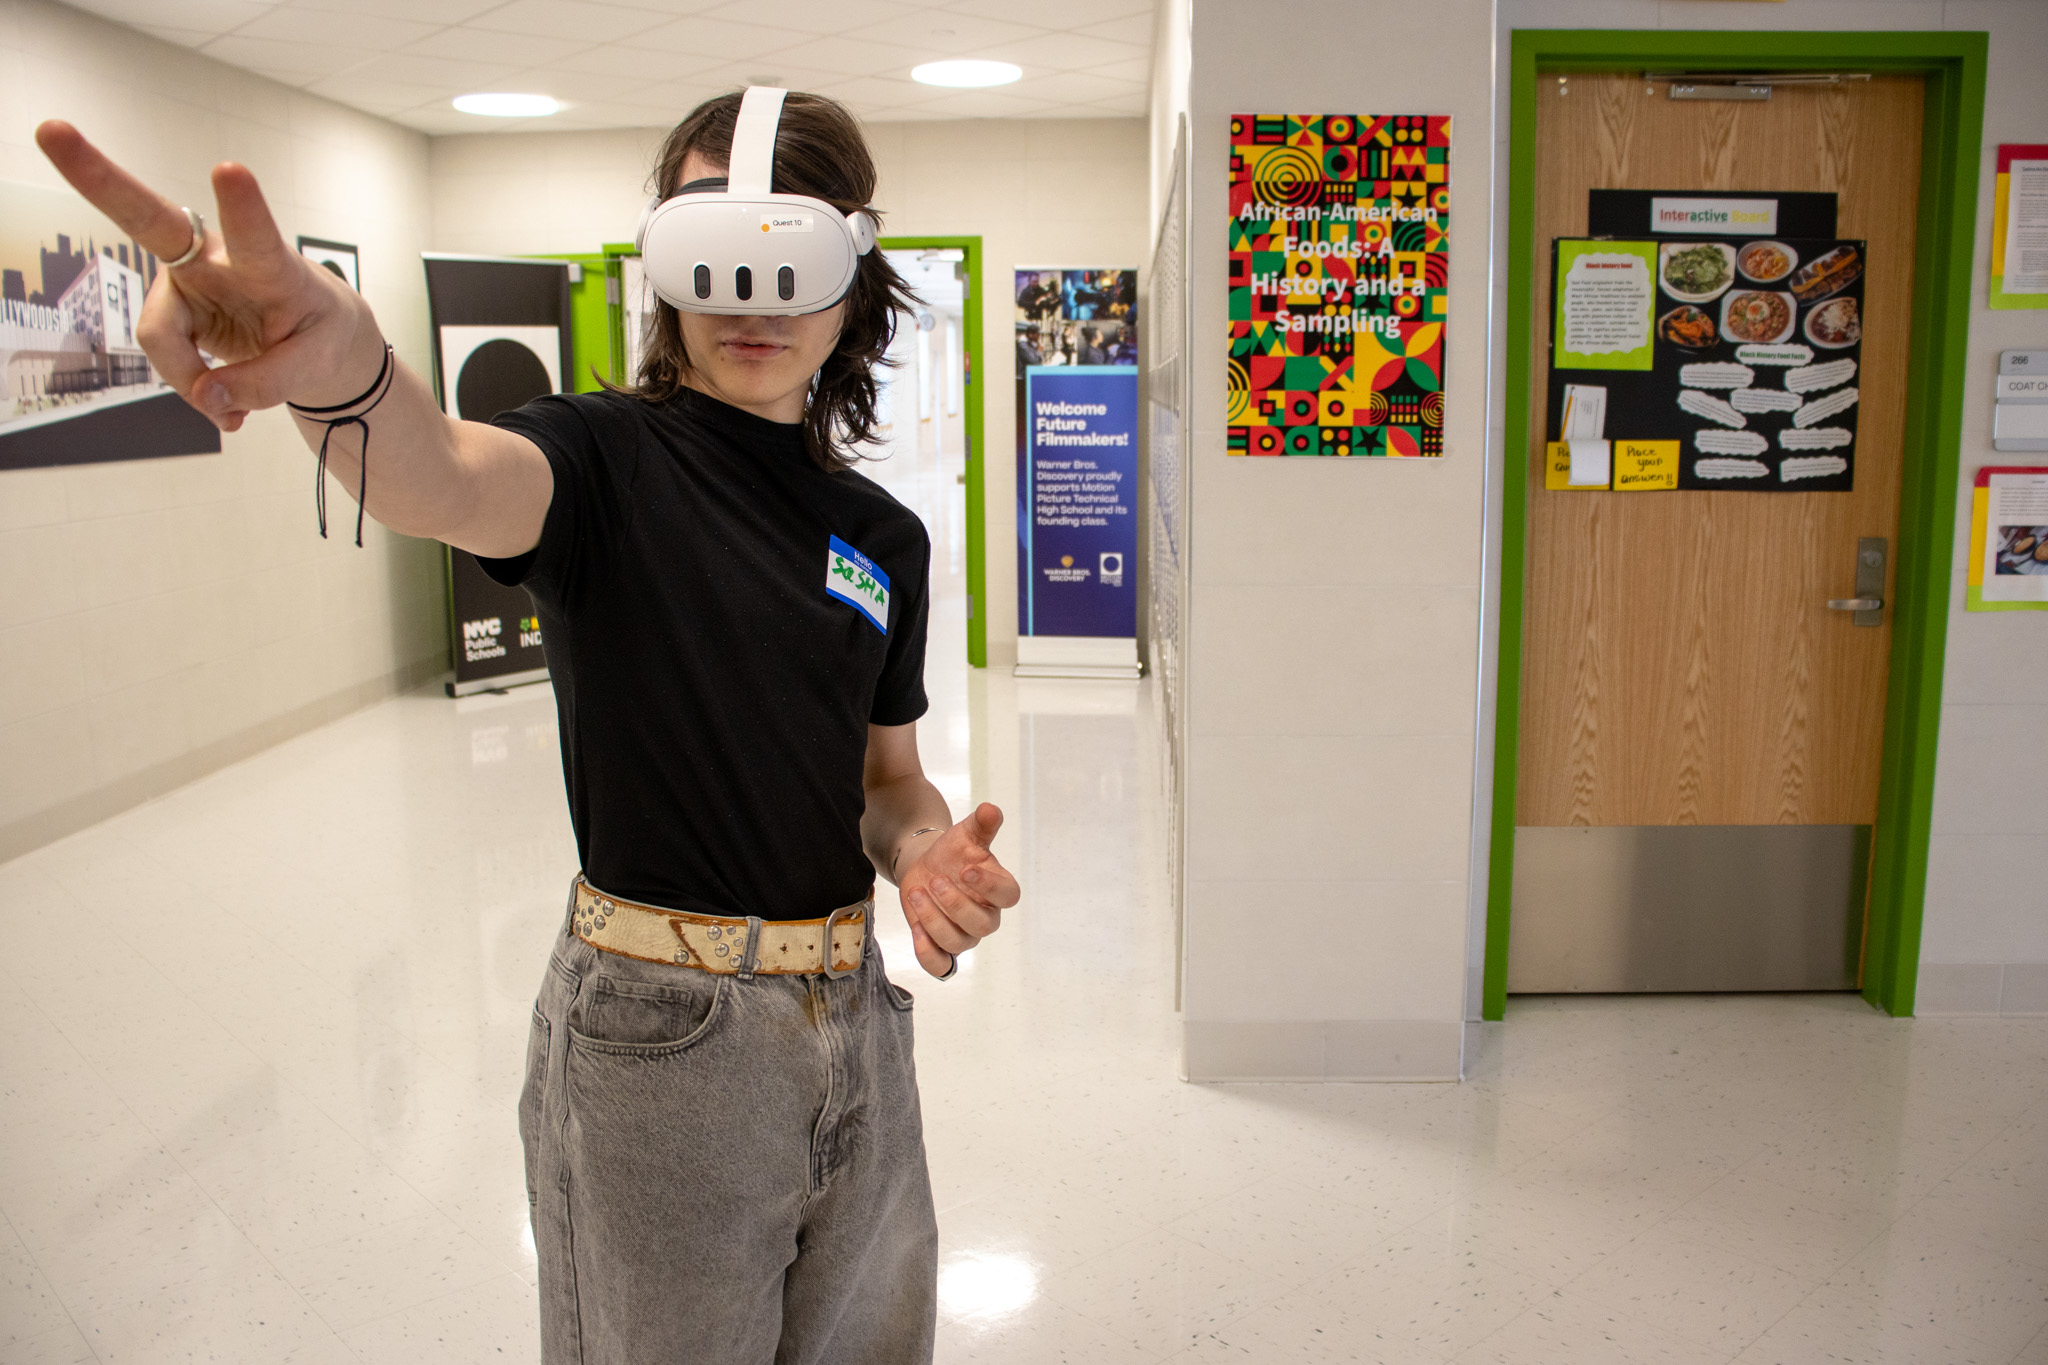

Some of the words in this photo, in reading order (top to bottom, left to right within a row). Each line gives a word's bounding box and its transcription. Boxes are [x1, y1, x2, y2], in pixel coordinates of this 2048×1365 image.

[1239, 201, 1437, 221] African-American
[1660, 208, 1728, 222] Interactive
[1731, 209, 1769, 222] Board
[1283, 235, 1371, 258] Foods:
[1377, 237, 1395, 258] A
[1250, 271, 1348, 301] History
[1354, 273, 1403, 296] and
[1411, 280, 1426, 296] a
[1274, 309, 1401, 339] Sampling
[2011, 356, 2029, 364] 266
[2008, 382, 2035, 391] COAT
[1036, 401, 1107, 416] Welcome
[1036, 418, 1087, 431] Future
[1036, 432, 1129, 446] Filmmakers!
[1627, 446, 1656, 457] Place
[1037, 460, 1072, 469] Warner
[1073, 460, 1098, 469] Bros.
[1037, 472, 1084, 482] Discovery
[1086, 471, 1122, 482] proudly
[1037, 483, 1080, 493] supports
[1082, 483, 1115, 491] Motion
[1037, 495, 1071, 503] Picture
[1073, 494, 1118, 503] Technical
[1037, 506, 1058, 516] High
[1060, 506, 1093, 514] School
[1095, 506, 1113, 514] and
[1115, 506, 1127, 514] its
[1037, 517, 1079, 527] founding
[1081, 517, 1108, 525] class.
[854, 551, 873, 570] Hello
[463, 617, 502, 639] NYC
[465, 636, 497, 650] Public
[466, 645, 506, 662] Schools
